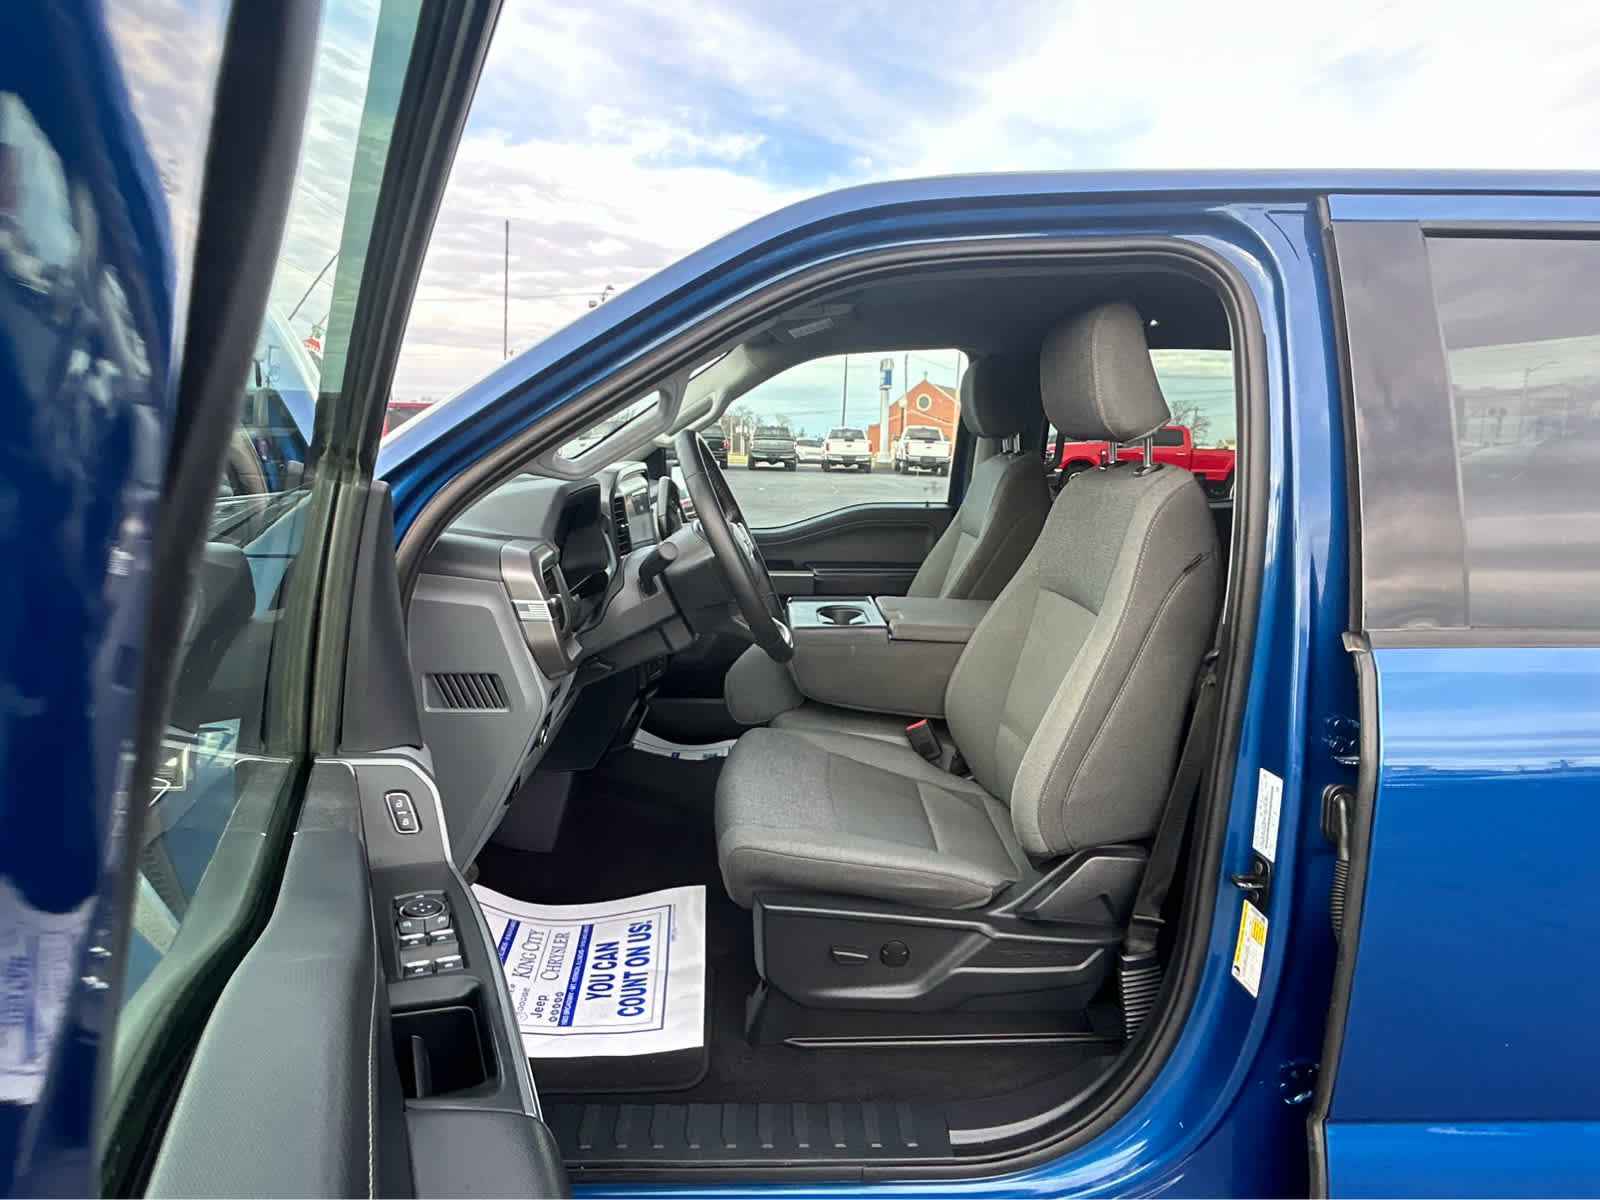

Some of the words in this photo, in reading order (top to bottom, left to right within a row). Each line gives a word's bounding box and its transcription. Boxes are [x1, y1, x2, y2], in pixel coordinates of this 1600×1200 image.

[627, 920, 653, 943] US!
[540, 932, 570, 980] CHRYSLER
[592, 941, 620, 970] CAN
[624, 946, 650, 967] ON
[585, 974, 615, 1000] YOU
[617, 971, 648, 1016] COUNT
[530, 995, 550, 1018] Jeep
